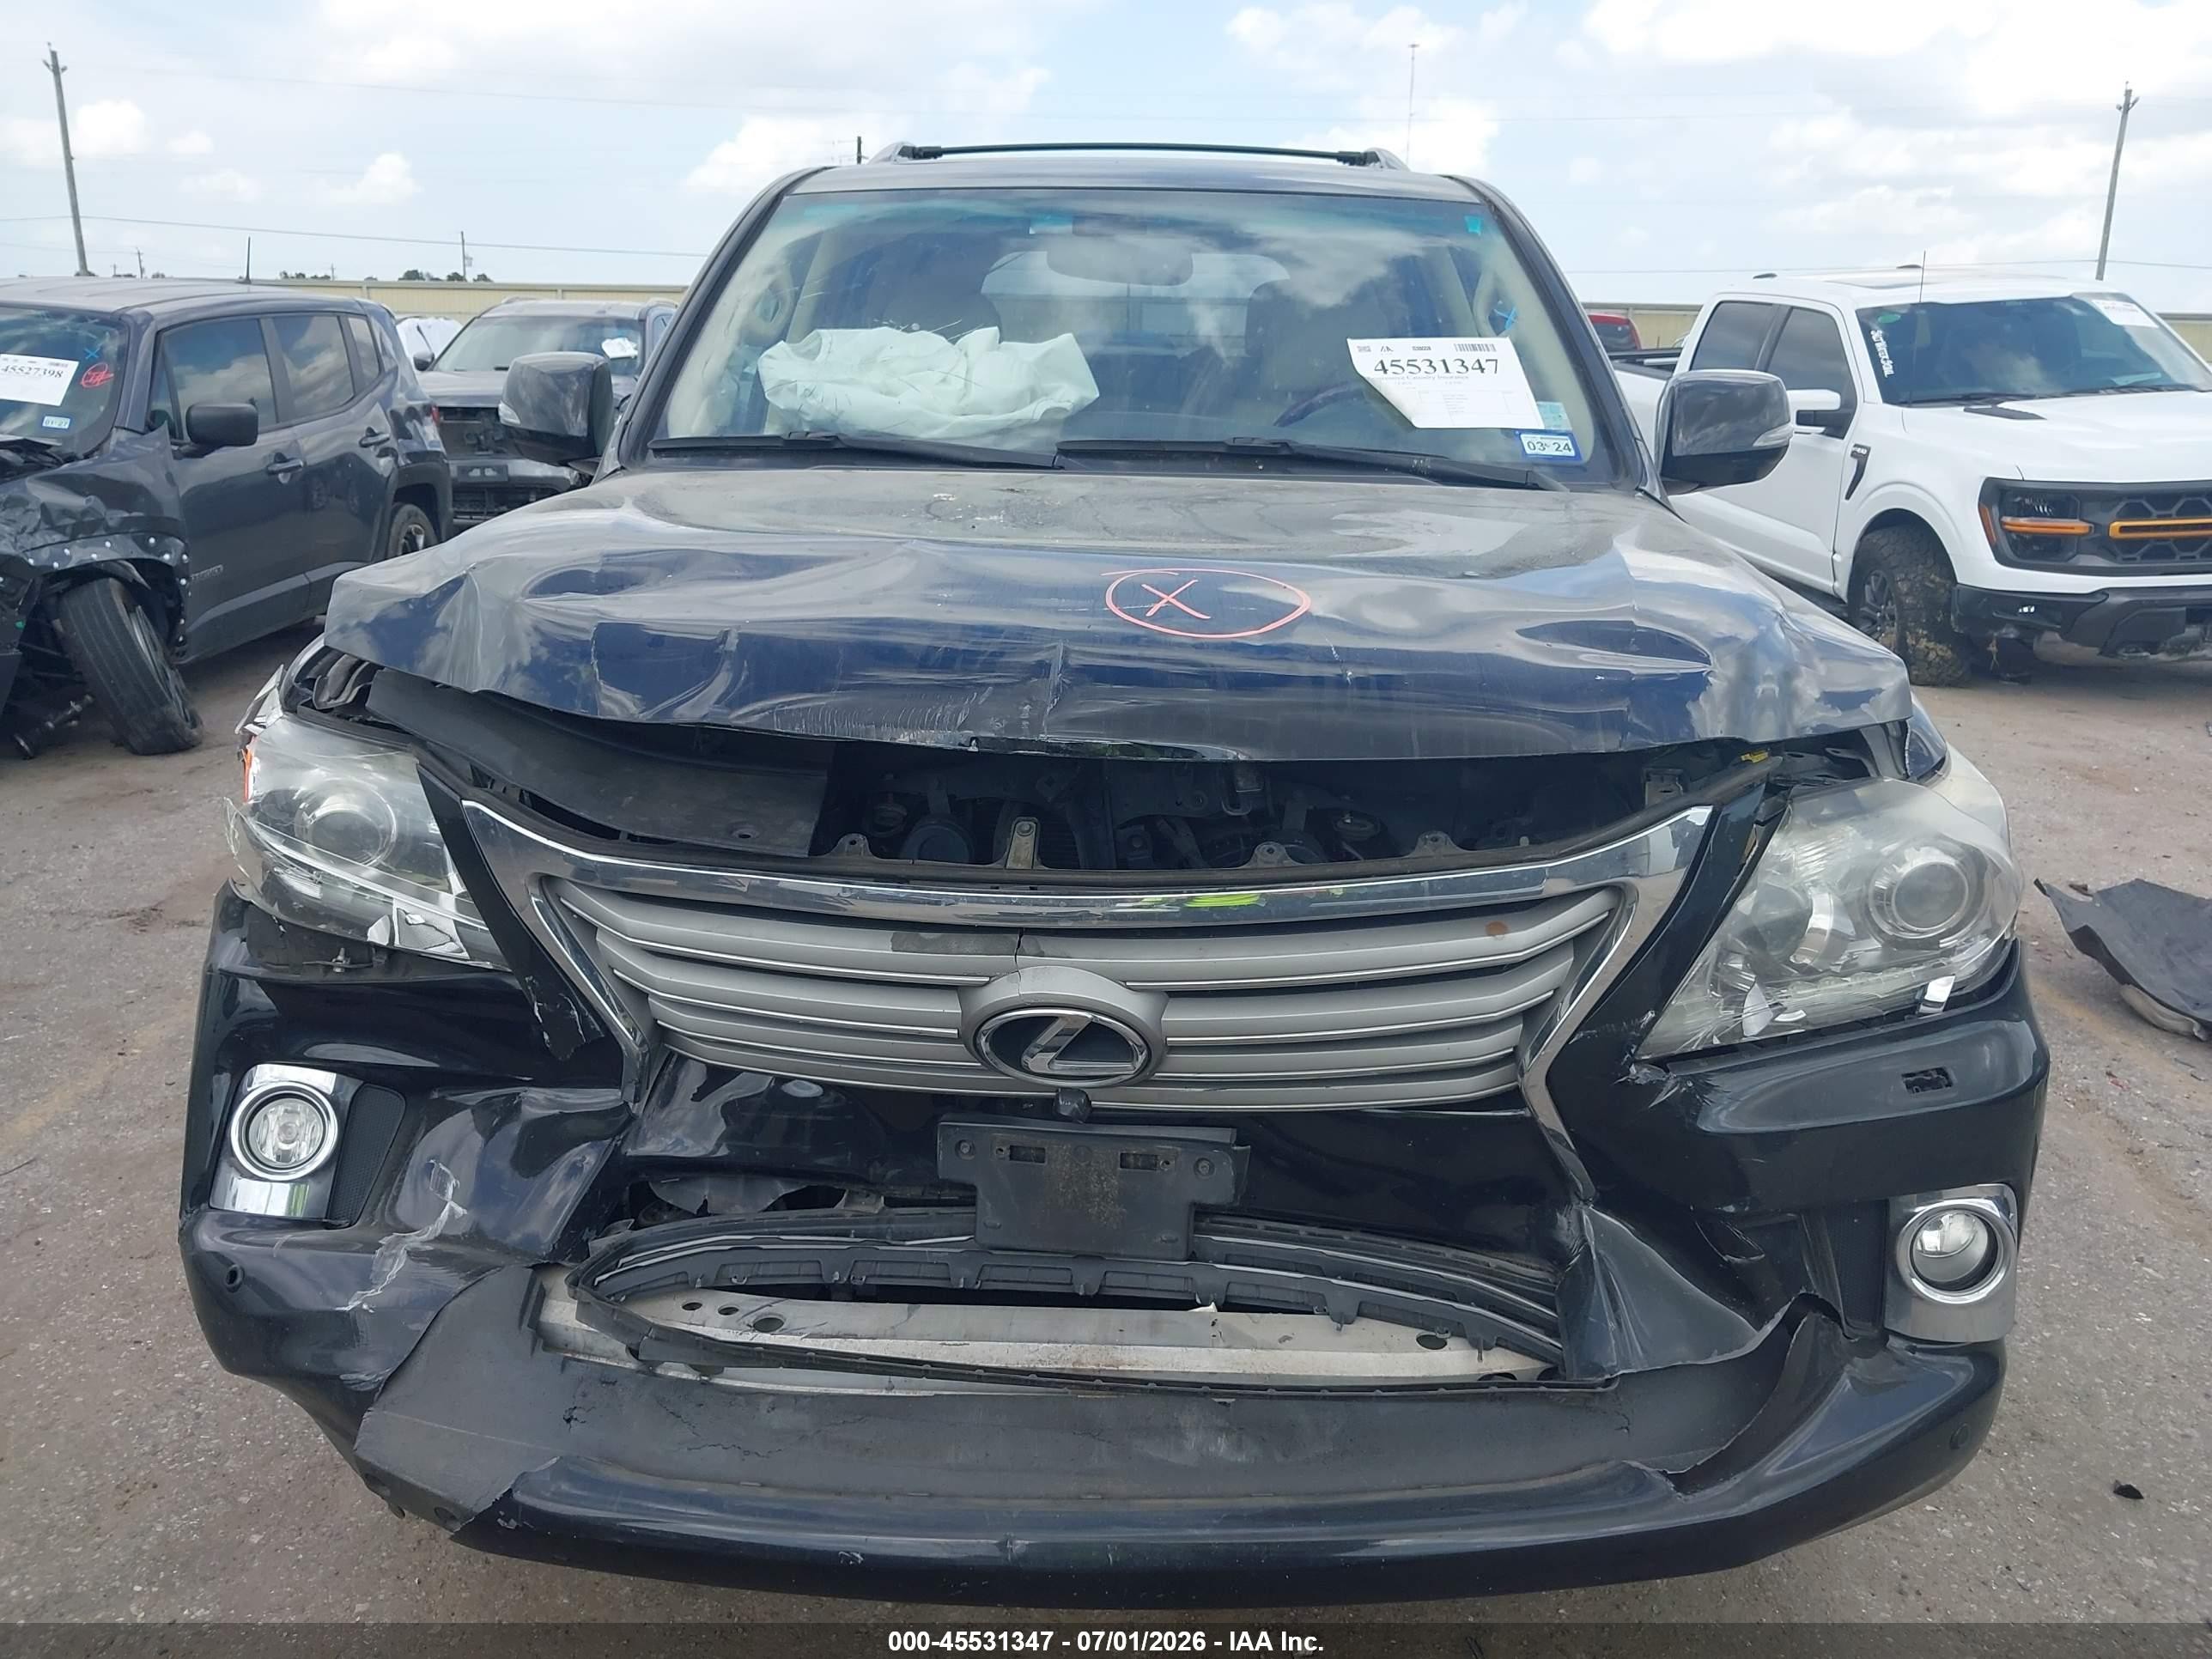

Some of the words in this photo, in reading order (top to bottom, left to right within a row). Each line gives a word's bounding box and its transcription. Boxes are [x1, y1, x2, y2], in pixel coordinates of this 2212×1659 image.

[1, 364, 64, 379] 45527398
[1374, 357, 1498, 374] 45531347
[1527, 441, 1546, 452] 03
[1552, 441, 1572, 453] 24
